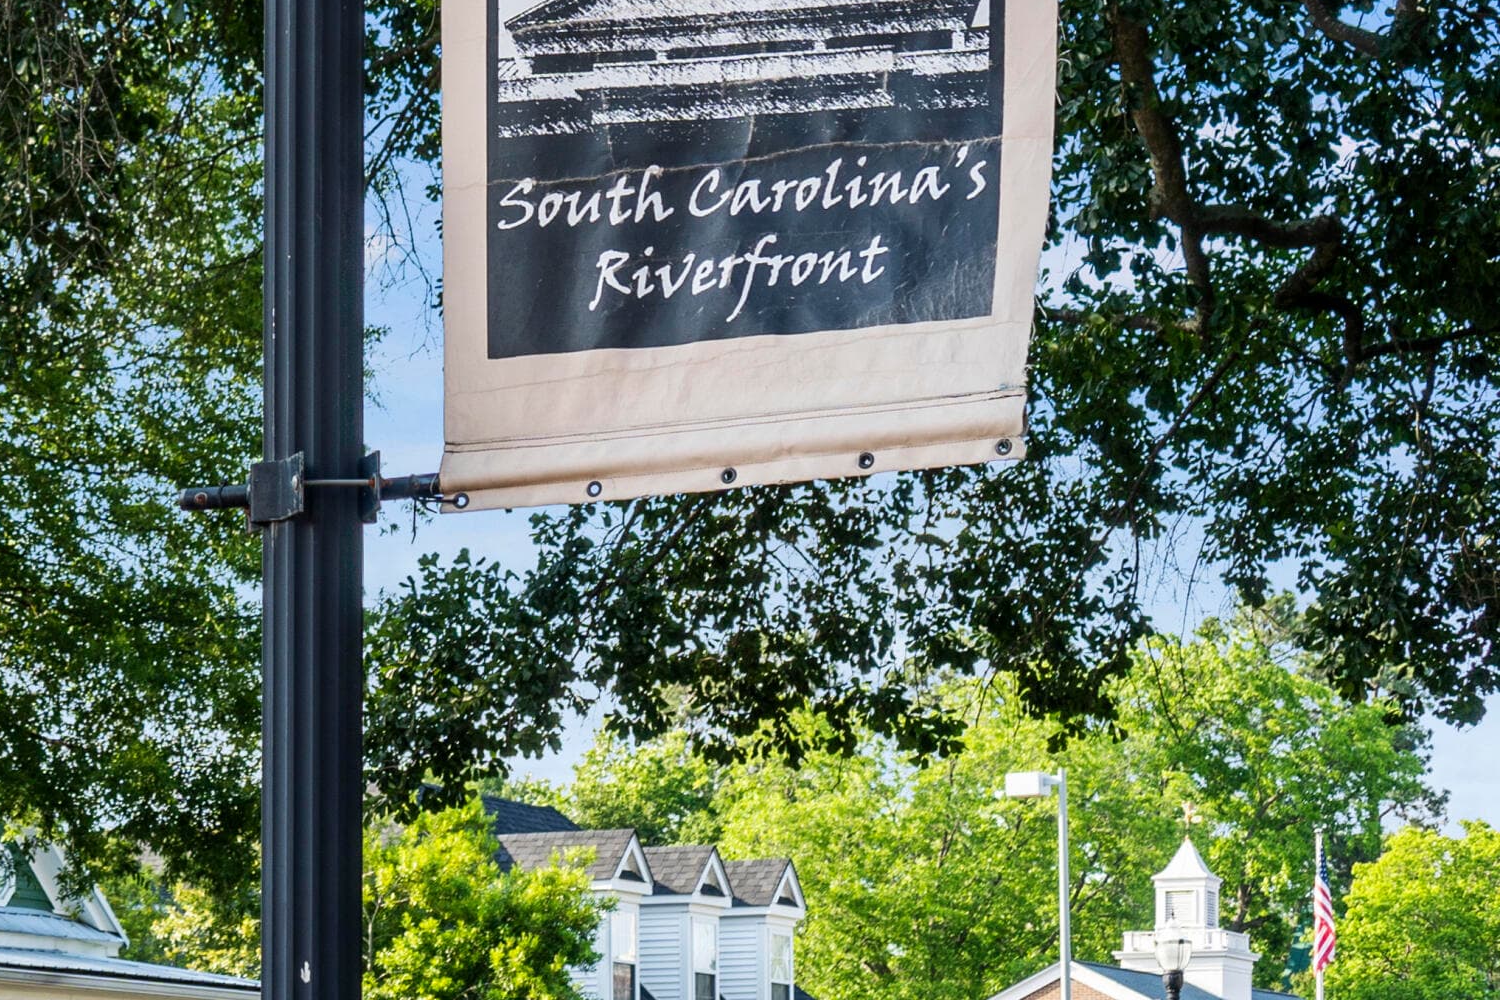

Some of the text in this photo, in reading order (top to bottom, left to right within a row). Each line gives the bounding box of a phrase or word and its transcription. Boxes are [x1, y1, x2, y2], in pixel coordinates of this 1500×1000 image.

[497, 146, 988, 231] South Carolina's
[589, 233, 889, 323] Riverfront
